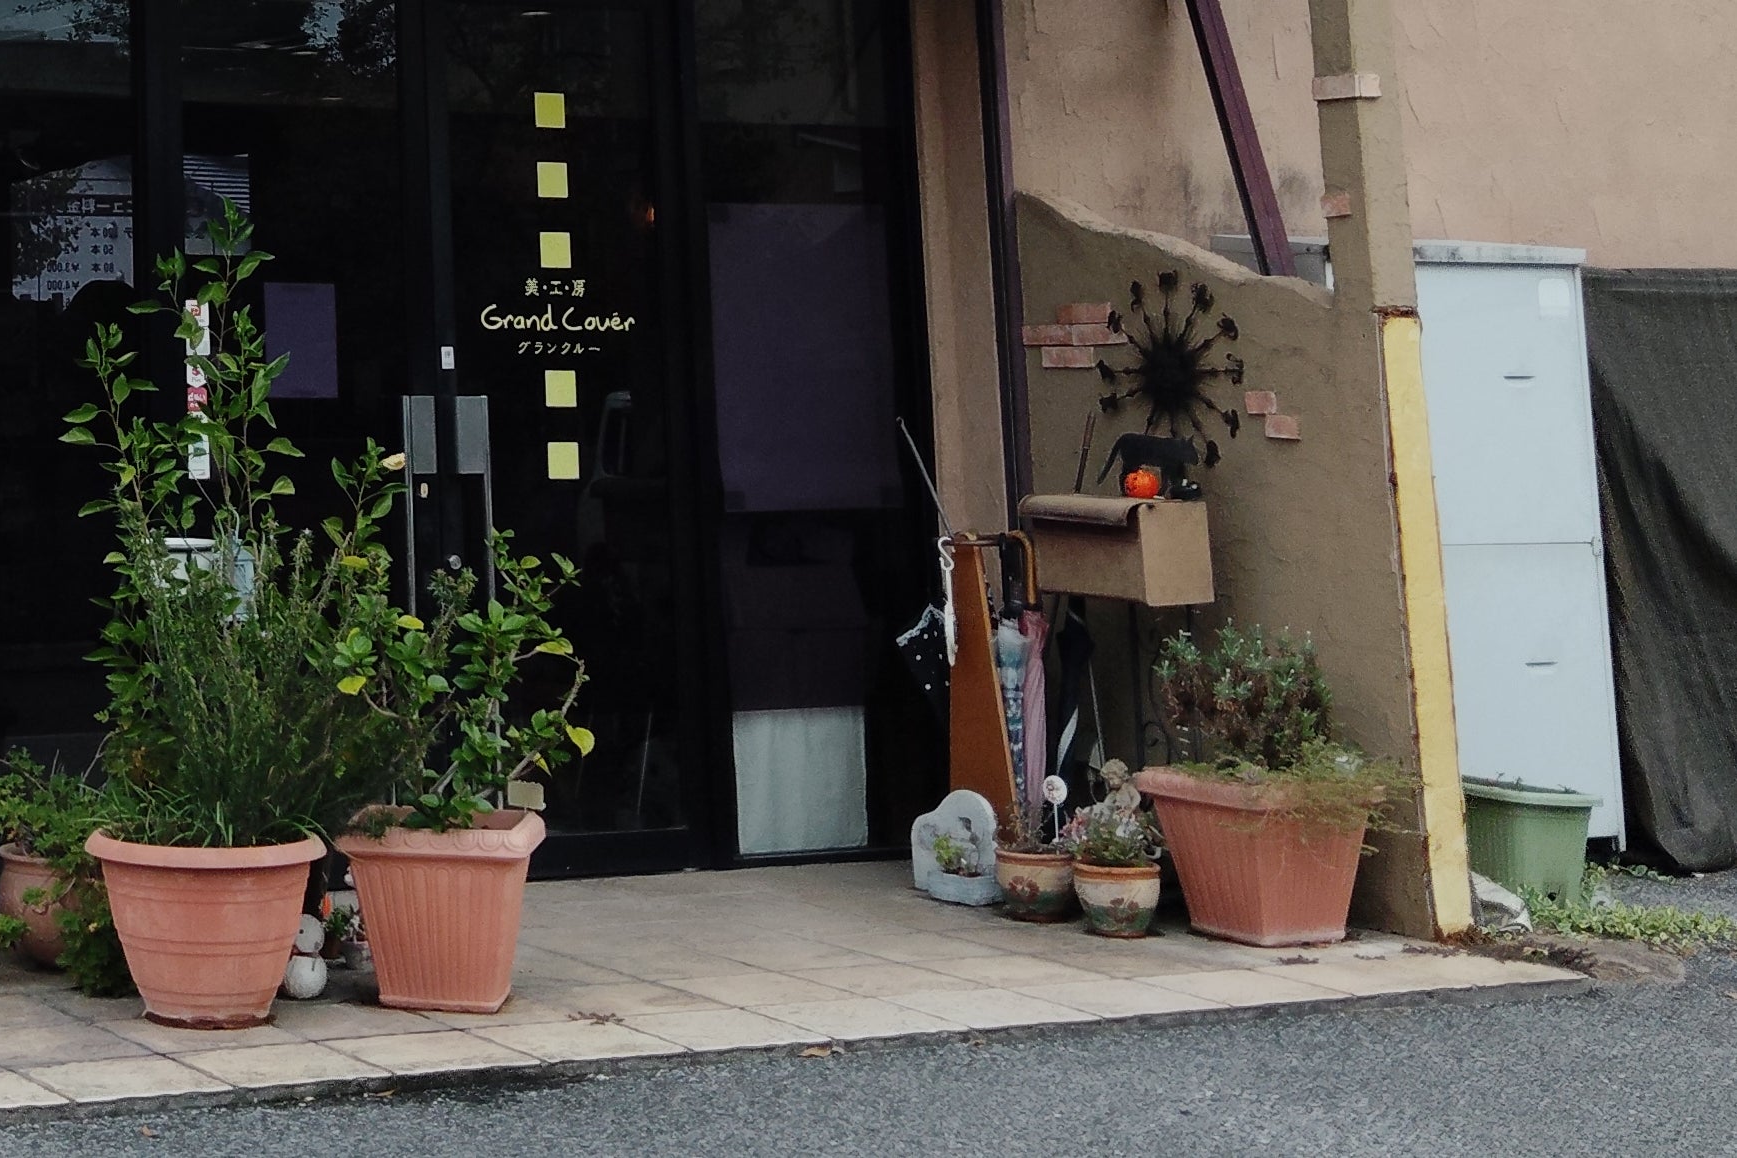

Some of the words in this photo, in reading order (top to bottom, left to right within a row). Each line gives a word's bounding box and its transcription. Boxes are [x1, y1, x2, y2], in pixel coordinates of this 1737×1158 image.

[480, 304, 558, 331] Grand
[518, 341, 601, 354] グランクルー
